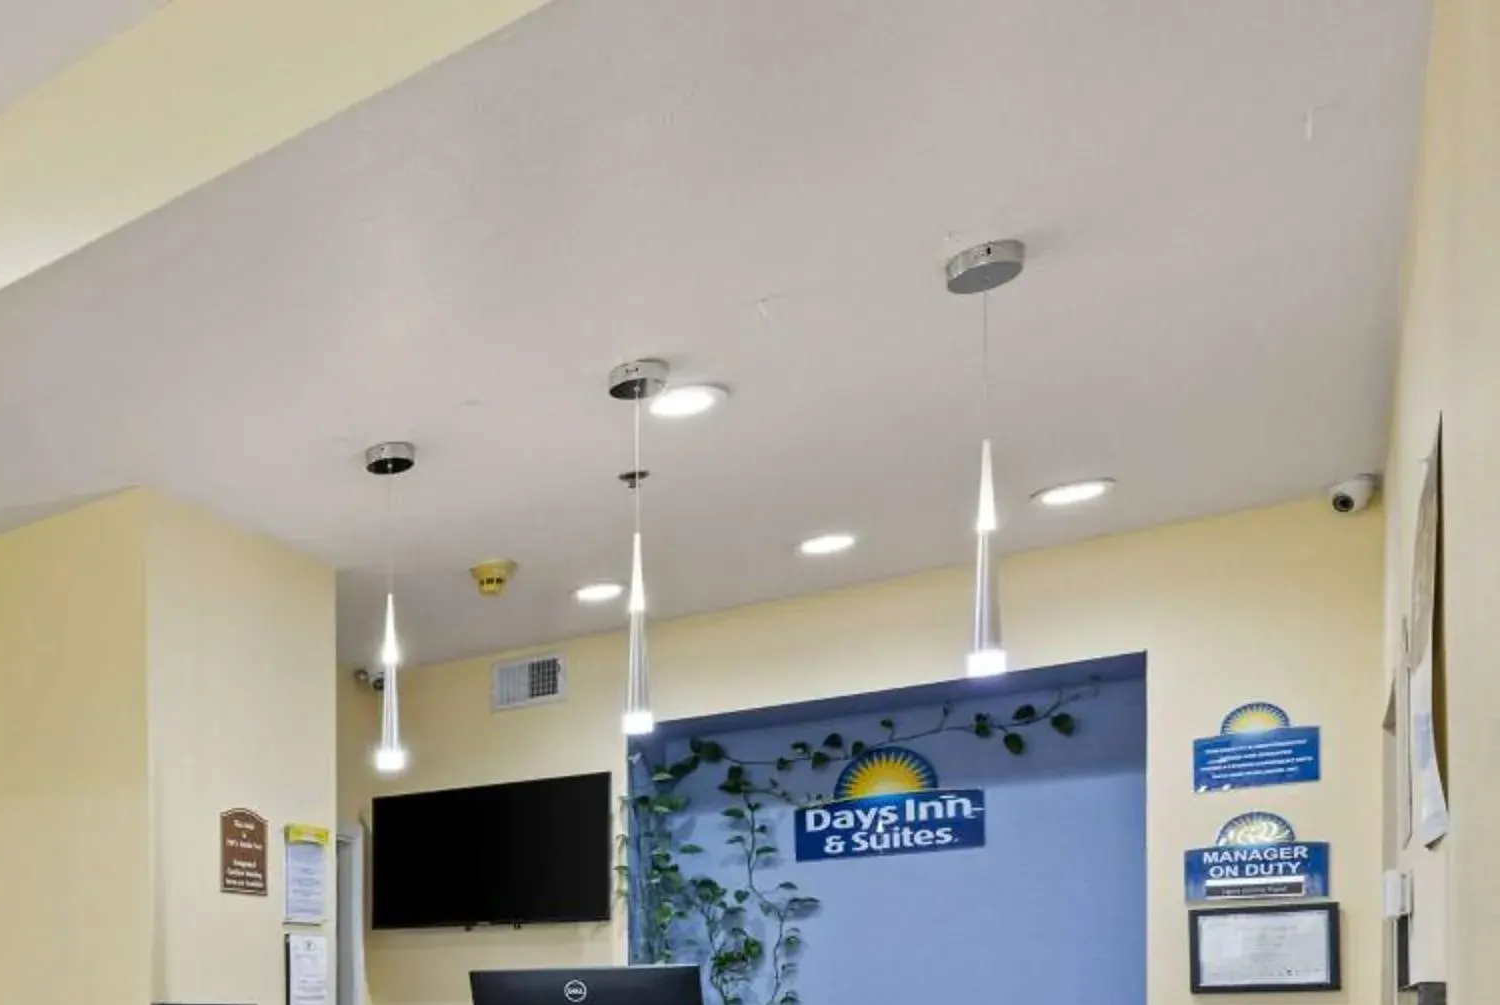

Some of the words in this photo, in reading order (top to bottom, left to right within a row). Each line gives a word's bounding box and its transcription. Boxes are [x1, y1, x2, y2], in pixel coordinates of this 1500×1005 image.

[805, 804, 899, 833] Days
[905, 796, 973, 822] Inn
[823, 834, 846, 854] &
[851, 826, 953, 851] Suites
[1203, 845, 1309, 864] MANAGER
[1209, 864, 1239, 878] ON
[1245, 861, 1301, 877] DUTY
